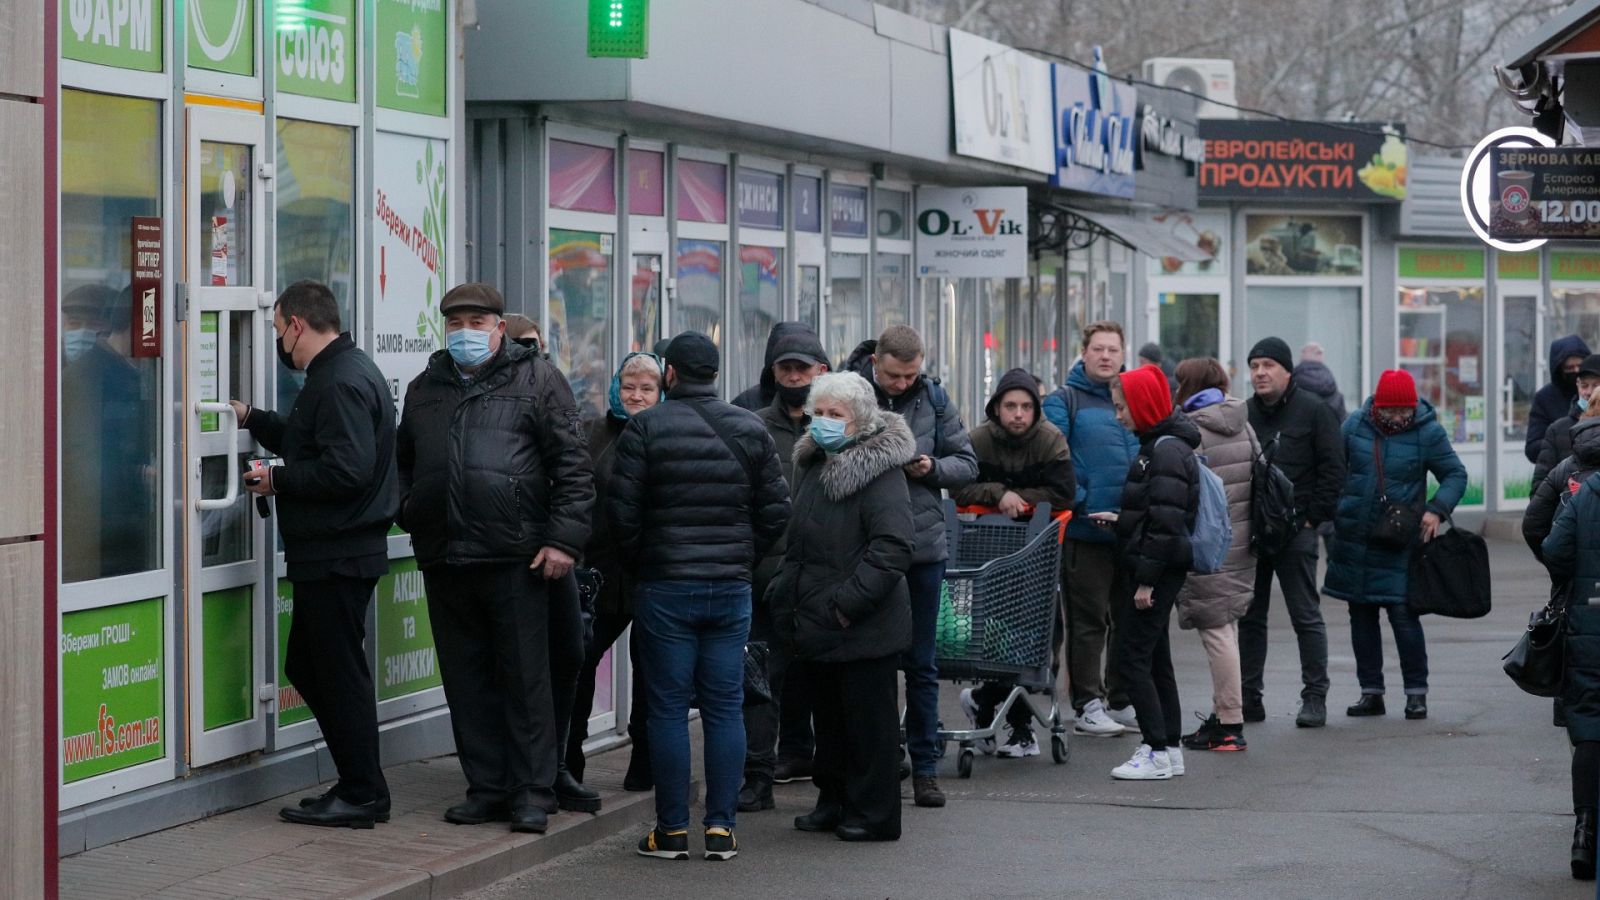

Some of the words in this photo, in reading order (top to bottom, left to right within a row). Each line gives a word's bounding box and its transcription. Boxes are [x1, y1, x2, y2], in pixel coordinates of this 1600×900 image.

[69, 0, 152, 52] ФАРМ
[280, 23, 345, 84] СОЮЗ
[1200, 162, 1354, 188] ПРОДУКТИ
[1499, 153, 1569, 165] ЗЕРНОВА
[1543, 173, 1595, 185] Еспресо
[1539, 200, 1600, 223] 12.00
[376, 189, 411, 247] Збережи
[412, 226, 438, 275] ГРОШІ
[376, 333, 403, 353] ЗАМОВ
[405, 334, 434, 353] онлайн!
[61, 632, 99, 655] Збережи
[101, 623, 130, 646] ГРОШІ
[403, 615, 416, 639] та
[102, 663, 129, 690] ЗАМОВ
[130, 658, 159, 683] онлайн!
[384, 646, 435, 687] ЗНИЖКИ
[63, 702, 160, 766] www.fs.com.ua
